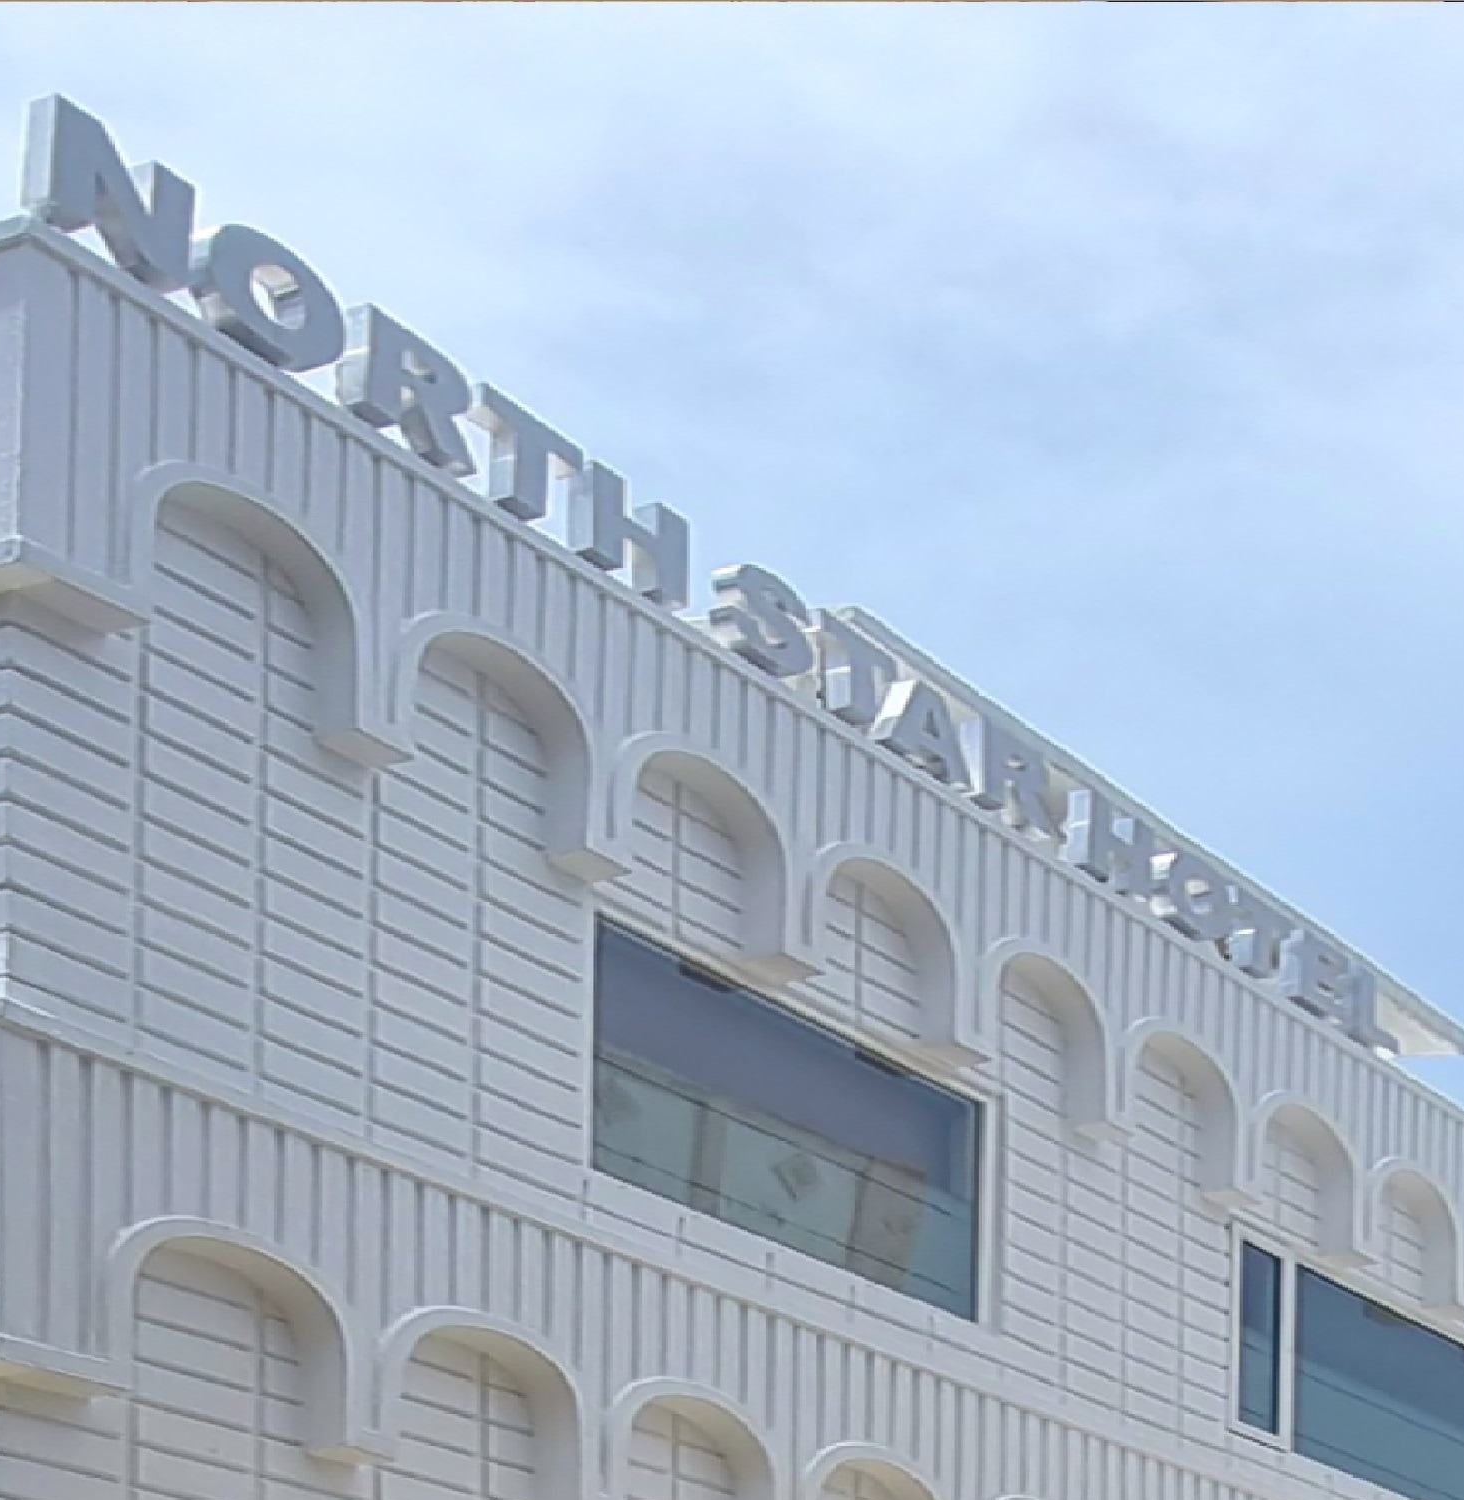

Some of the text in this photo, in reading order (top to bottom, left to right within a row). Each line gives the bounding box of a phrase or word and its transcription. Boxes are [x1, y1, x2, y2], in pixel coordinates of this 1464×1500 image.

[23, 93, 1400, 1056] NORTH STAR HOTEL
